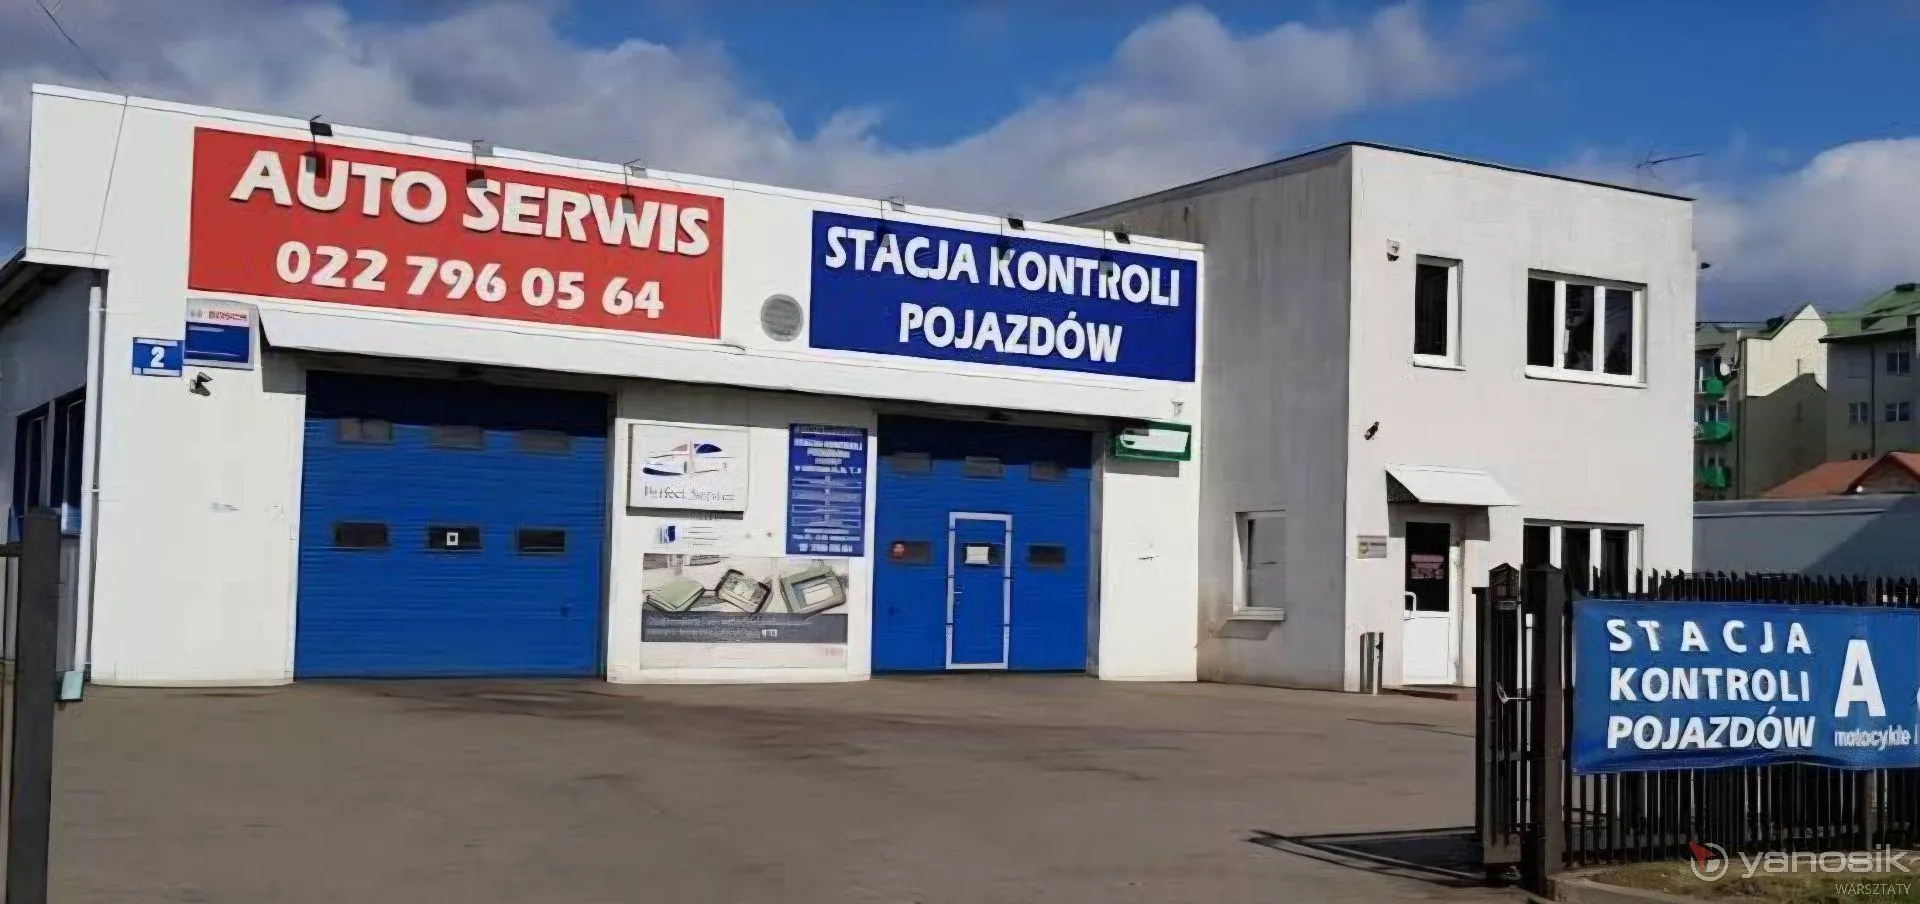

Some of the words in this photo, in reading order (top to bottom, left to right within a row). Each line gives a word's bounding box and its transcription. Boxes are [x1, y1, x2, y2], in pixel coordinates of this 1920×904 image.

[230, 149, 447, 224] AUTO
[462, 177, 710, 257] SERWIS
[275, 240, 388, 292] 022
[405, 255, 507, 303] 796
[521, 267, 585, 310] 05
[601, 277, 665, 319] 64
[825, 225, 980, 285] STACJA
[989, 245, 1180, 308] KONTROLI
[150, 346, 166, 368] 2
[898, 301, 1123, 364] POJAZDÓW
[1606, 619, 1812, 654] STACJA
[1610, 667, 1811, 703] KONTROLI
[1834, 639, 1887, 718] A
[1607, 705, 1816, 750] POJAZDÓW
[1834, 724, 1911, 751] motocykle
